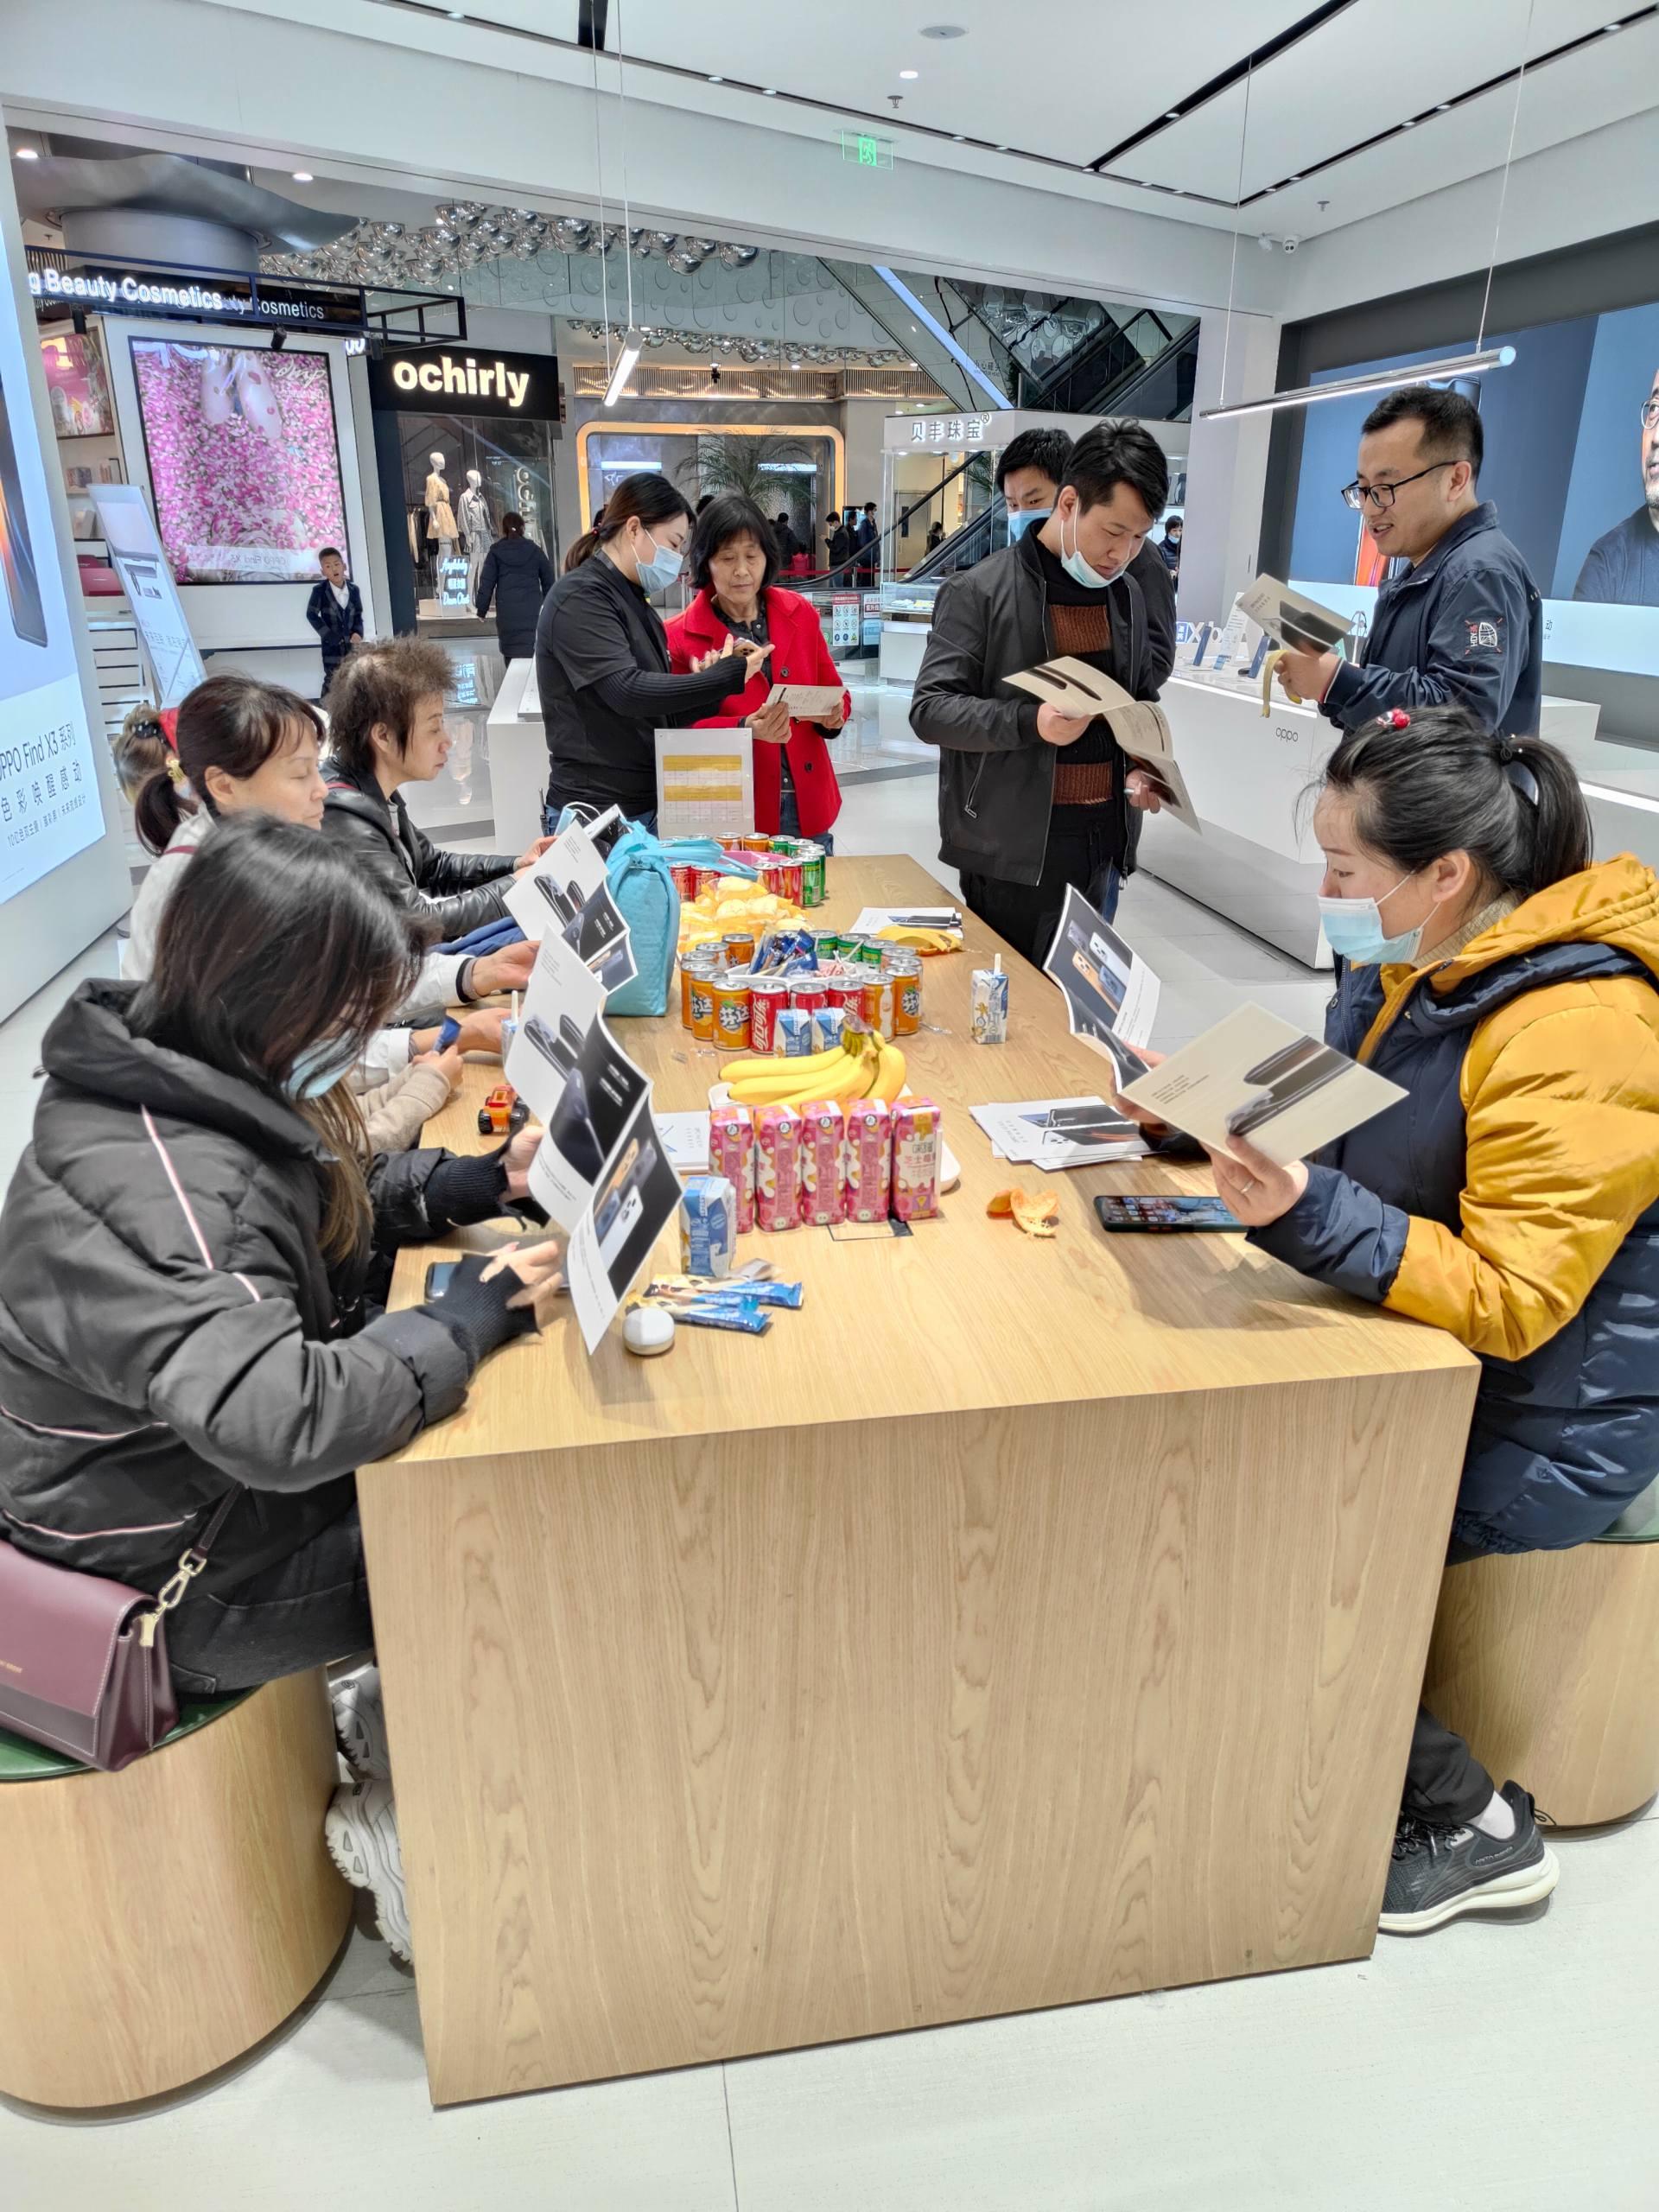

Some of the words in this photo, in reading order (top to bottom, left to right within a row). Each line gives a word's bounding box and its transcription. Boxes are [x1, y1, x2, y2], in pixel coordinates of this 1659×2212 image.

[45, 268, 116, 302] Beauty
[122, 276, 223, 310] Cosmetics
[393, 355, 530, 408] ochirly
[912, 419, 981, 442] 贝丰珠宝
[0, 747, 22, 781] PPO
[22, 734, 45, 768] Find
[44, 730, 59, 758] X3
[59, 721, 76, 751] 系列
